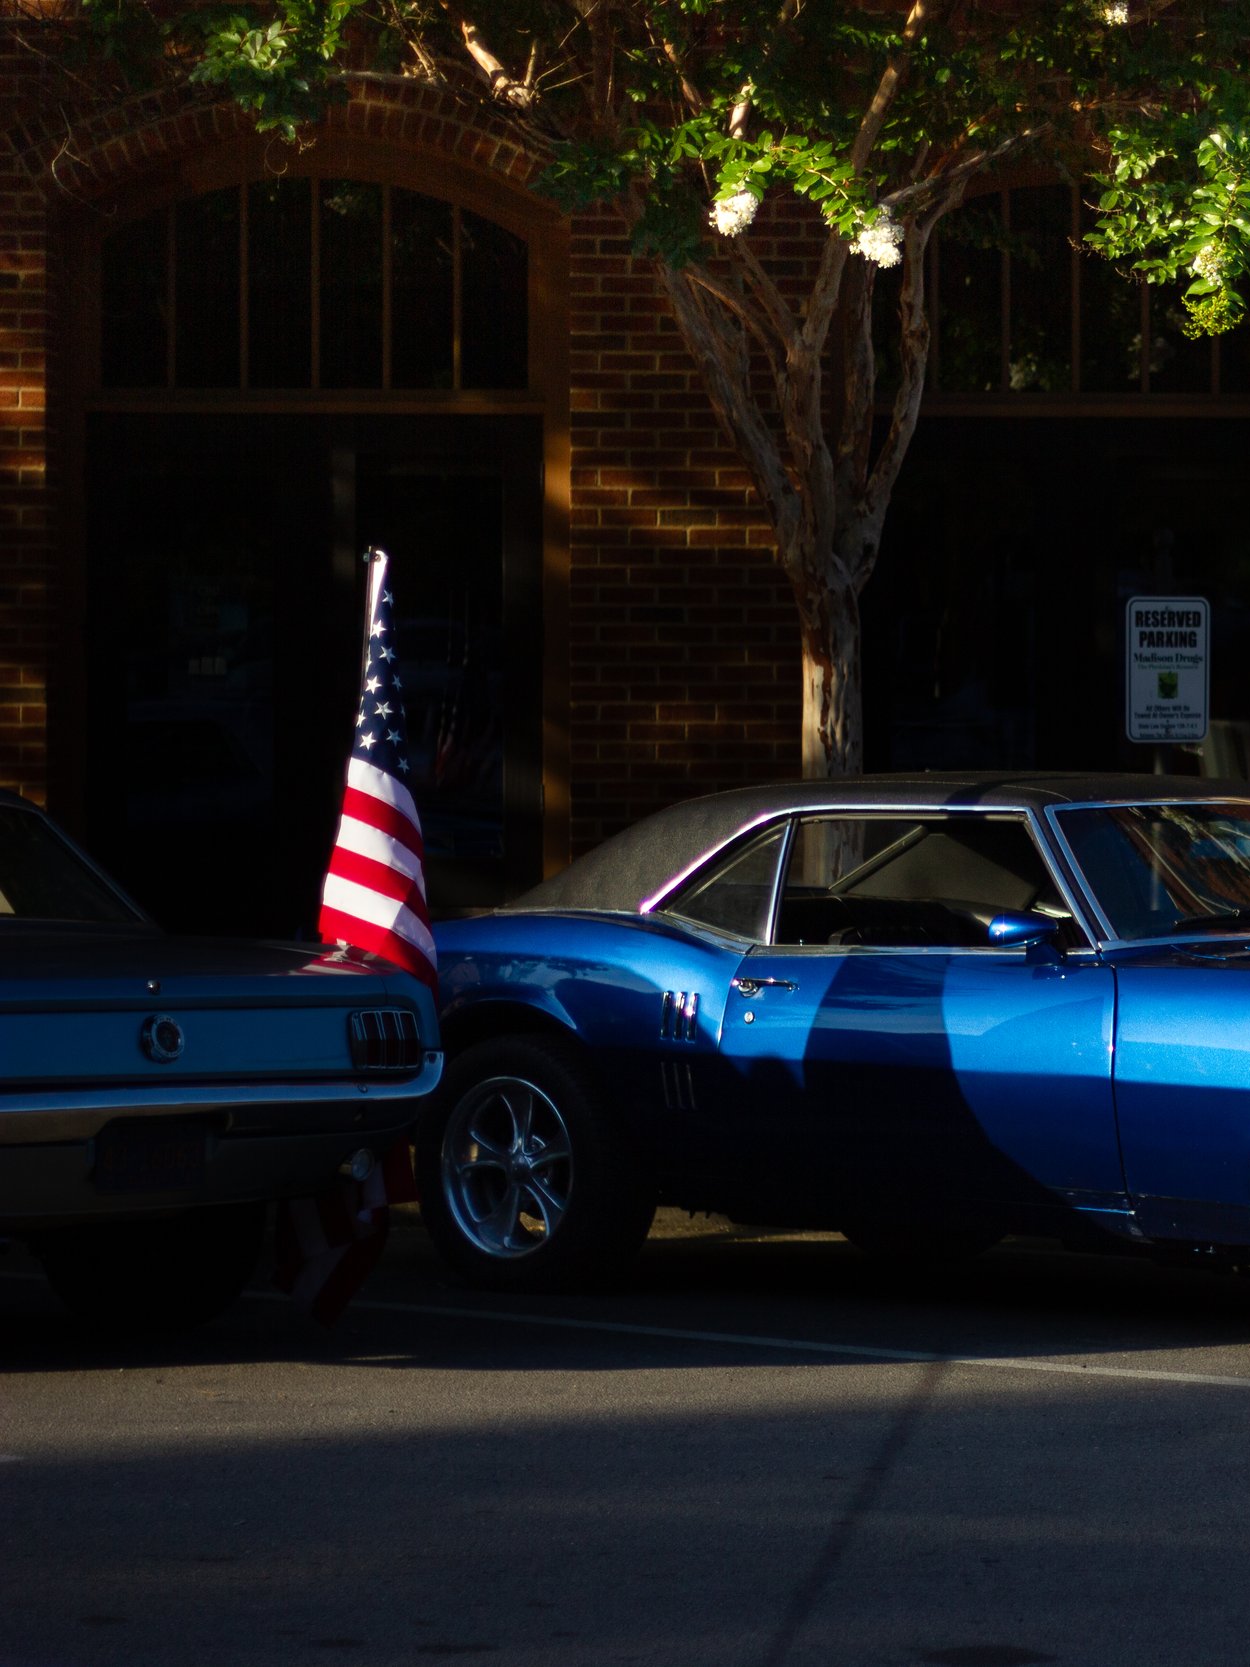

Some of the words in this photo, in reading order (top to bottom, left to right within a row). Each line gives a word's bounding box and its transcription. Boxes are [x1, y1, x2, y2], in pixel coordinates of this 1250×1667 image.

[1135, 611, 1201, 628] RESERVED
[1139, 631, 1197, 648] PARKING
[1134, 652, 1174, 664] Madison
[1175, 652, 1203, 665] Drugs
